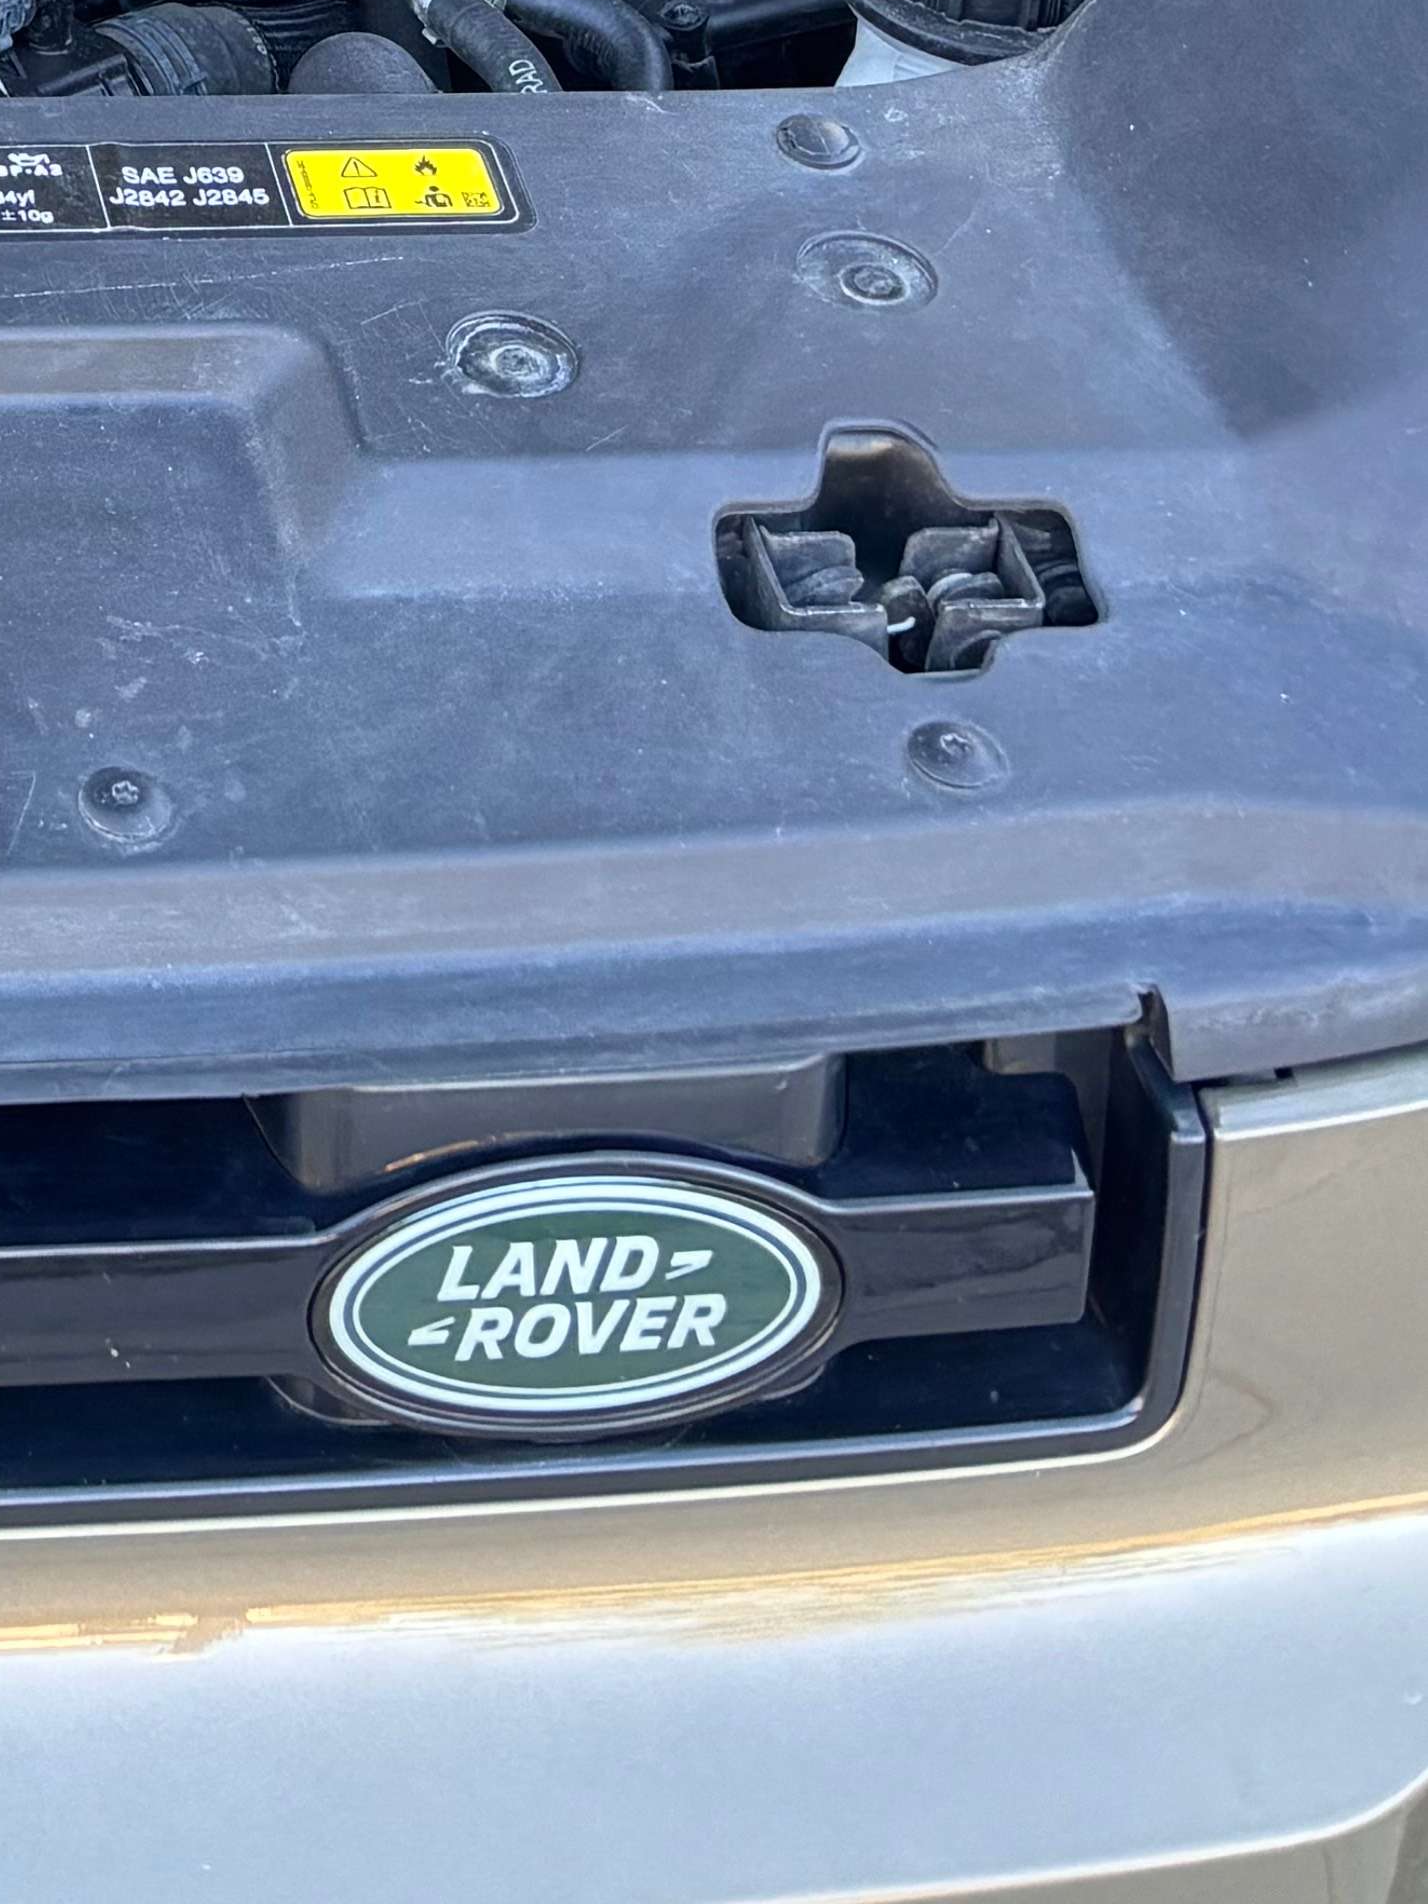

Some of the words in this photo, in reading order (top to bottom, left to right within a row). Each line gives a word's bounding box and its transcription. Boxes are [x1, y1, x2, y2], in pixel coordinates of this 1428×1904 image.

[508, 59, 548, 93] RAD
[121, 166, 178, 185] SAE
[183, 166, 245, 185] J639
[109, 187, 187, 207] J2842
[193, 187, 270, 206] J2845
[1, 208, 54, 225] ±10g
[437, 1235, 660, 1302] LAND
[453, 1293, 728, 1362] ROVER
